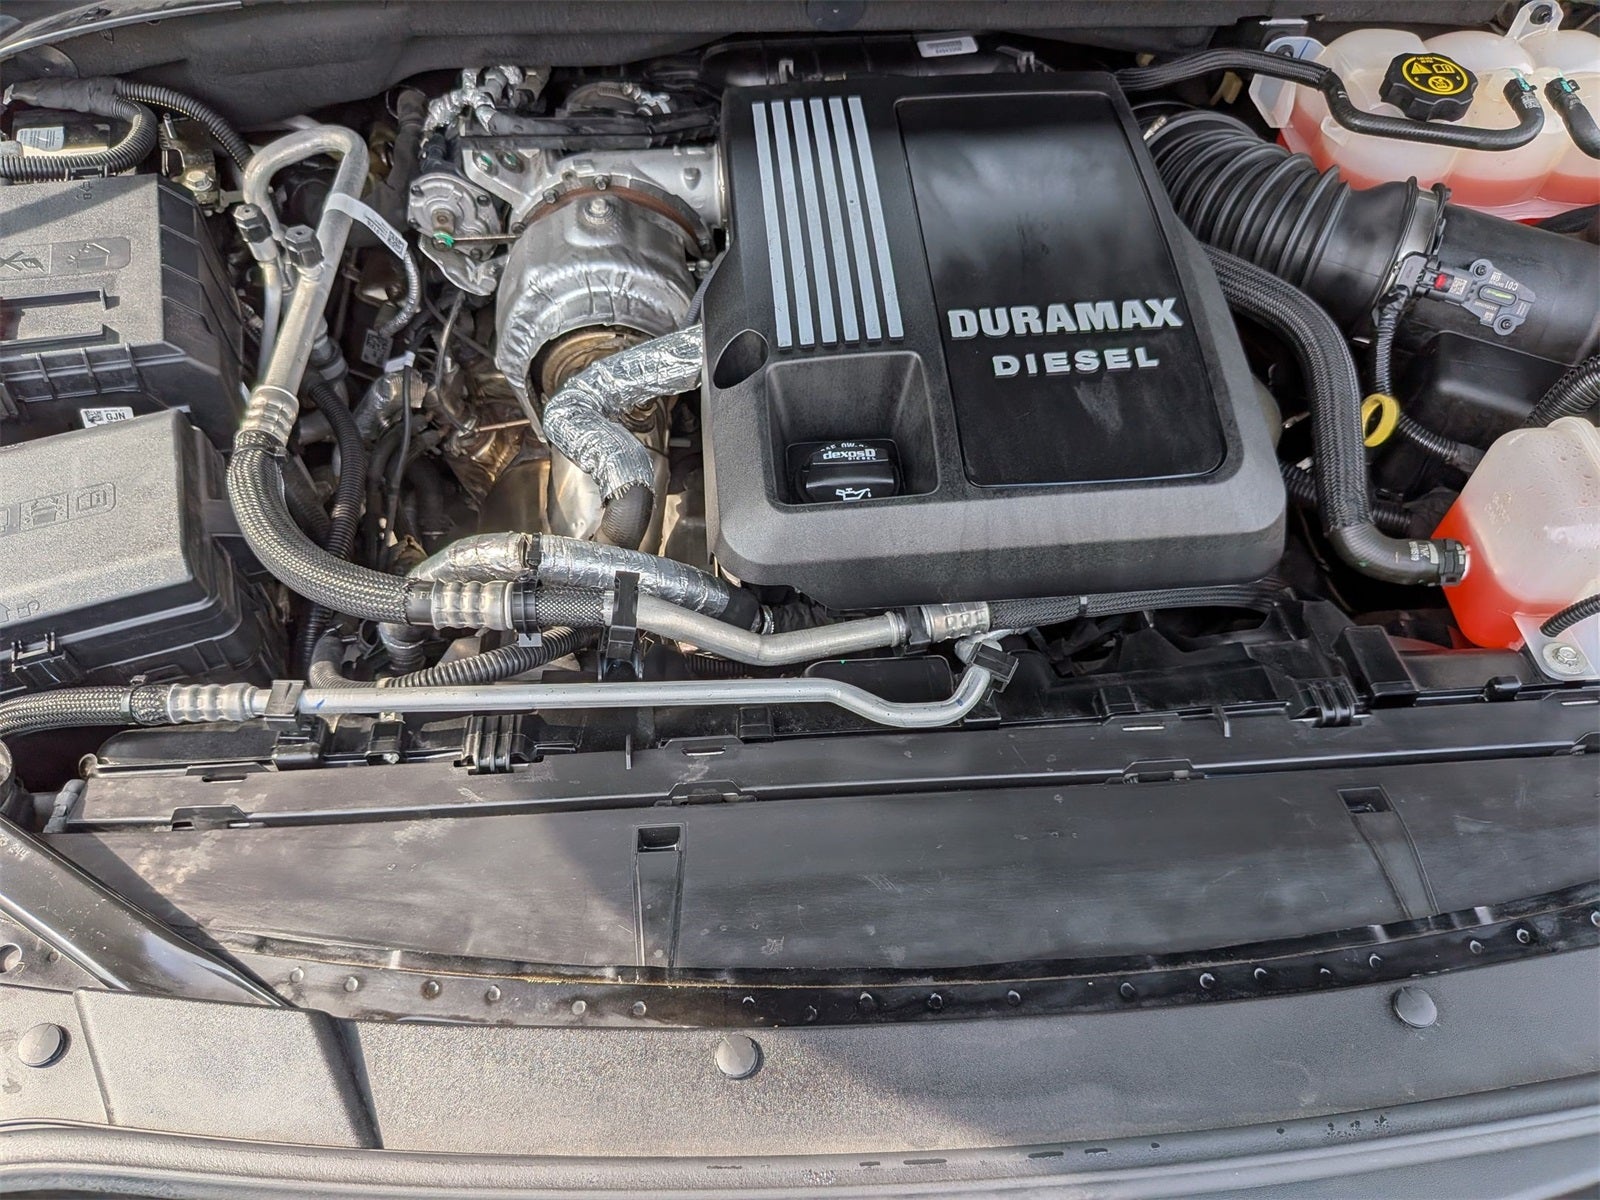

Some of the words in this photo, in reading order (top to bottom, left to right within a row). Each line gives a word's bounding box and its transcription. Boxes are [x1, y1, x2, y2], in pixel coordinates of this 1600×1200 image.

[948, 298, 1183, 340] DURAMAX
[992, 347, 1159, 377] DIESEL
[105, 411, 126, 421] GJN
